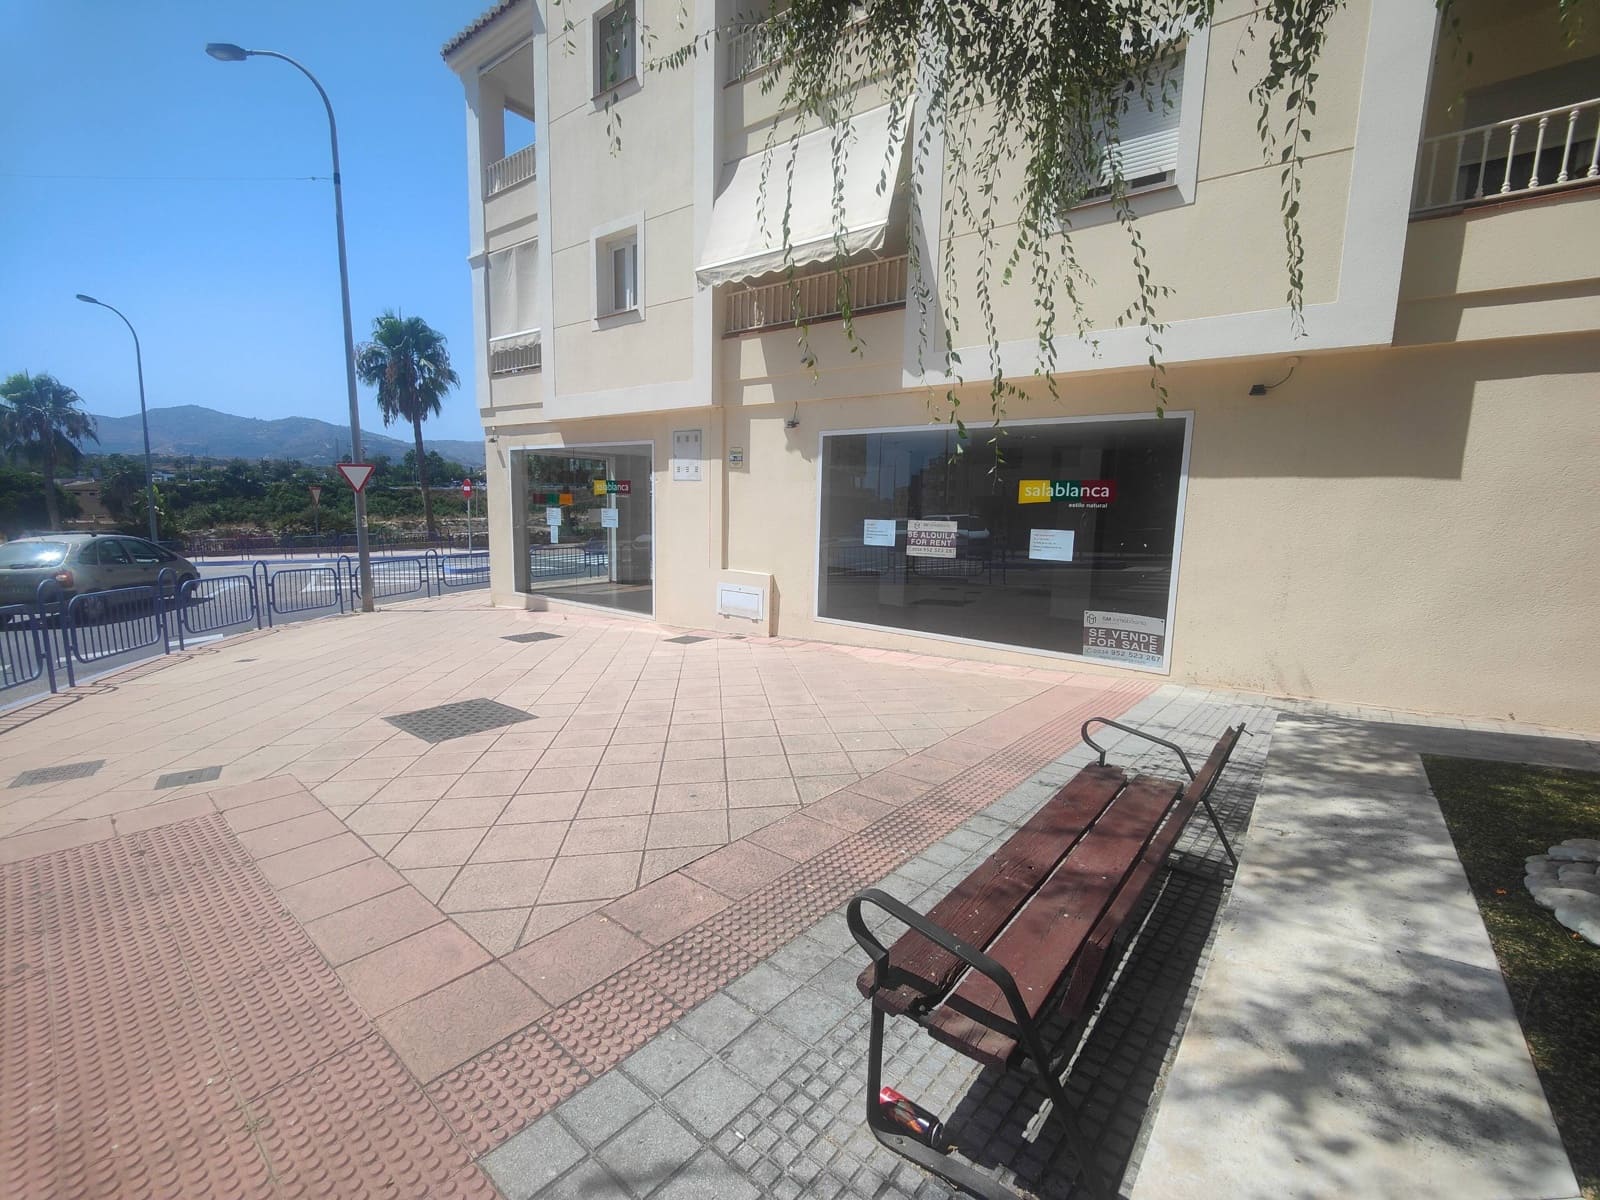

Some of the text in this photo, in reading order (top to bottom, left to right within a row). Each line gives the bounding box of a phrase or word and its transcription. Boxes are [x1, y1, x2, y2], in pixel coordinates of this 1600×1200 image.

[1024, 482, 1110, 497] salablanca
[910, 538, 952, 547] FOR RENT
[1088, 628, 1158, 645] SE VENDE
[1088, 637, 1158, 654] FOR SALE
[1111, 649, 1125, 657] 952
[1128, 651, 1143, 659] 523
